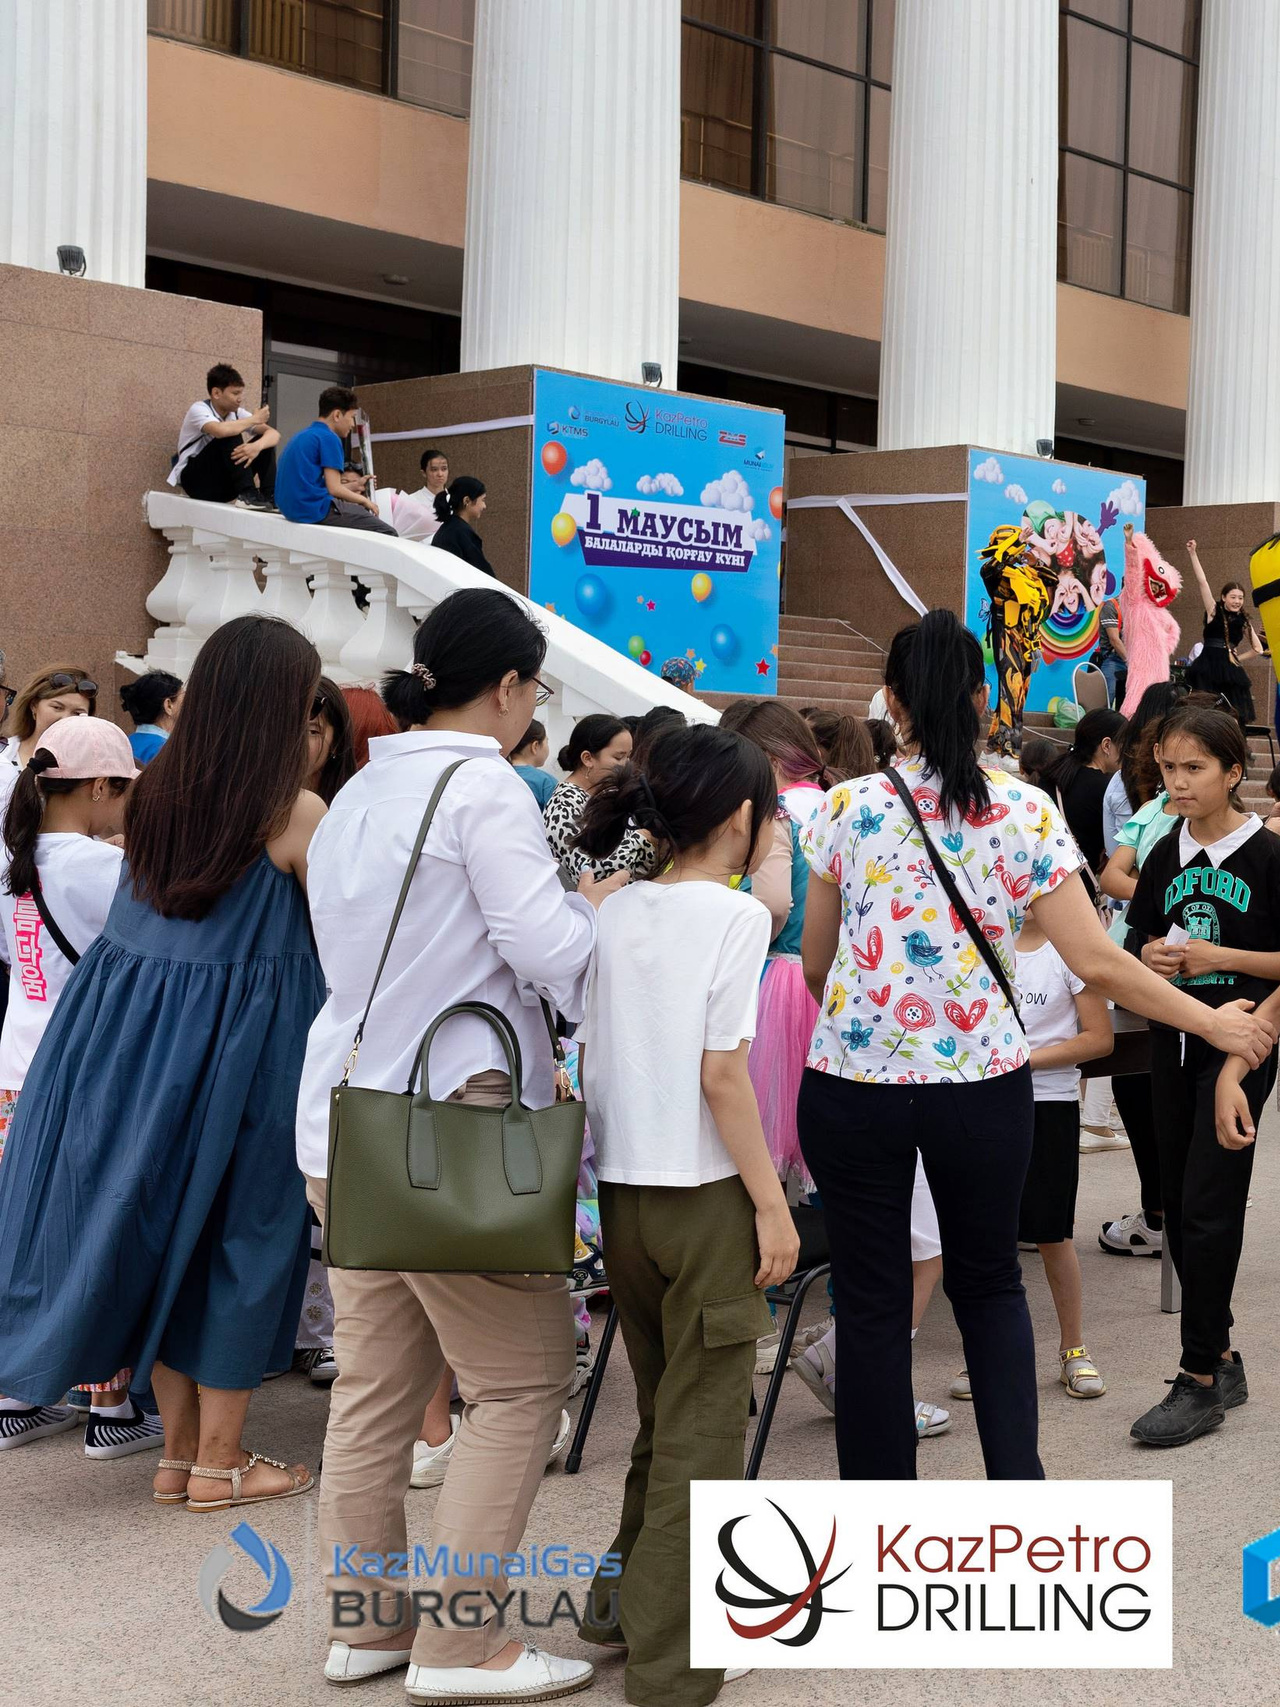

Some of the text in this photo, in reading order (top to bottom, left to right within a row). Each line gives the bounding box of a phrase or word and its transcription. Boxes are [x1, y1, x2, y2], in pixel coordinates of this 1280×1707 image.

[655, 409, 708, 429] KazPetro
[562, 425, 588, 437] KTMS
[655, 422, 708, 441] DRILLING
[586, 493, 743, 549] 1 МАУСЫМ
[585, 536, 664, 558] БАЛАЛАРДЫ
[666, 546, 713, 563] ҚОРҒАУ
